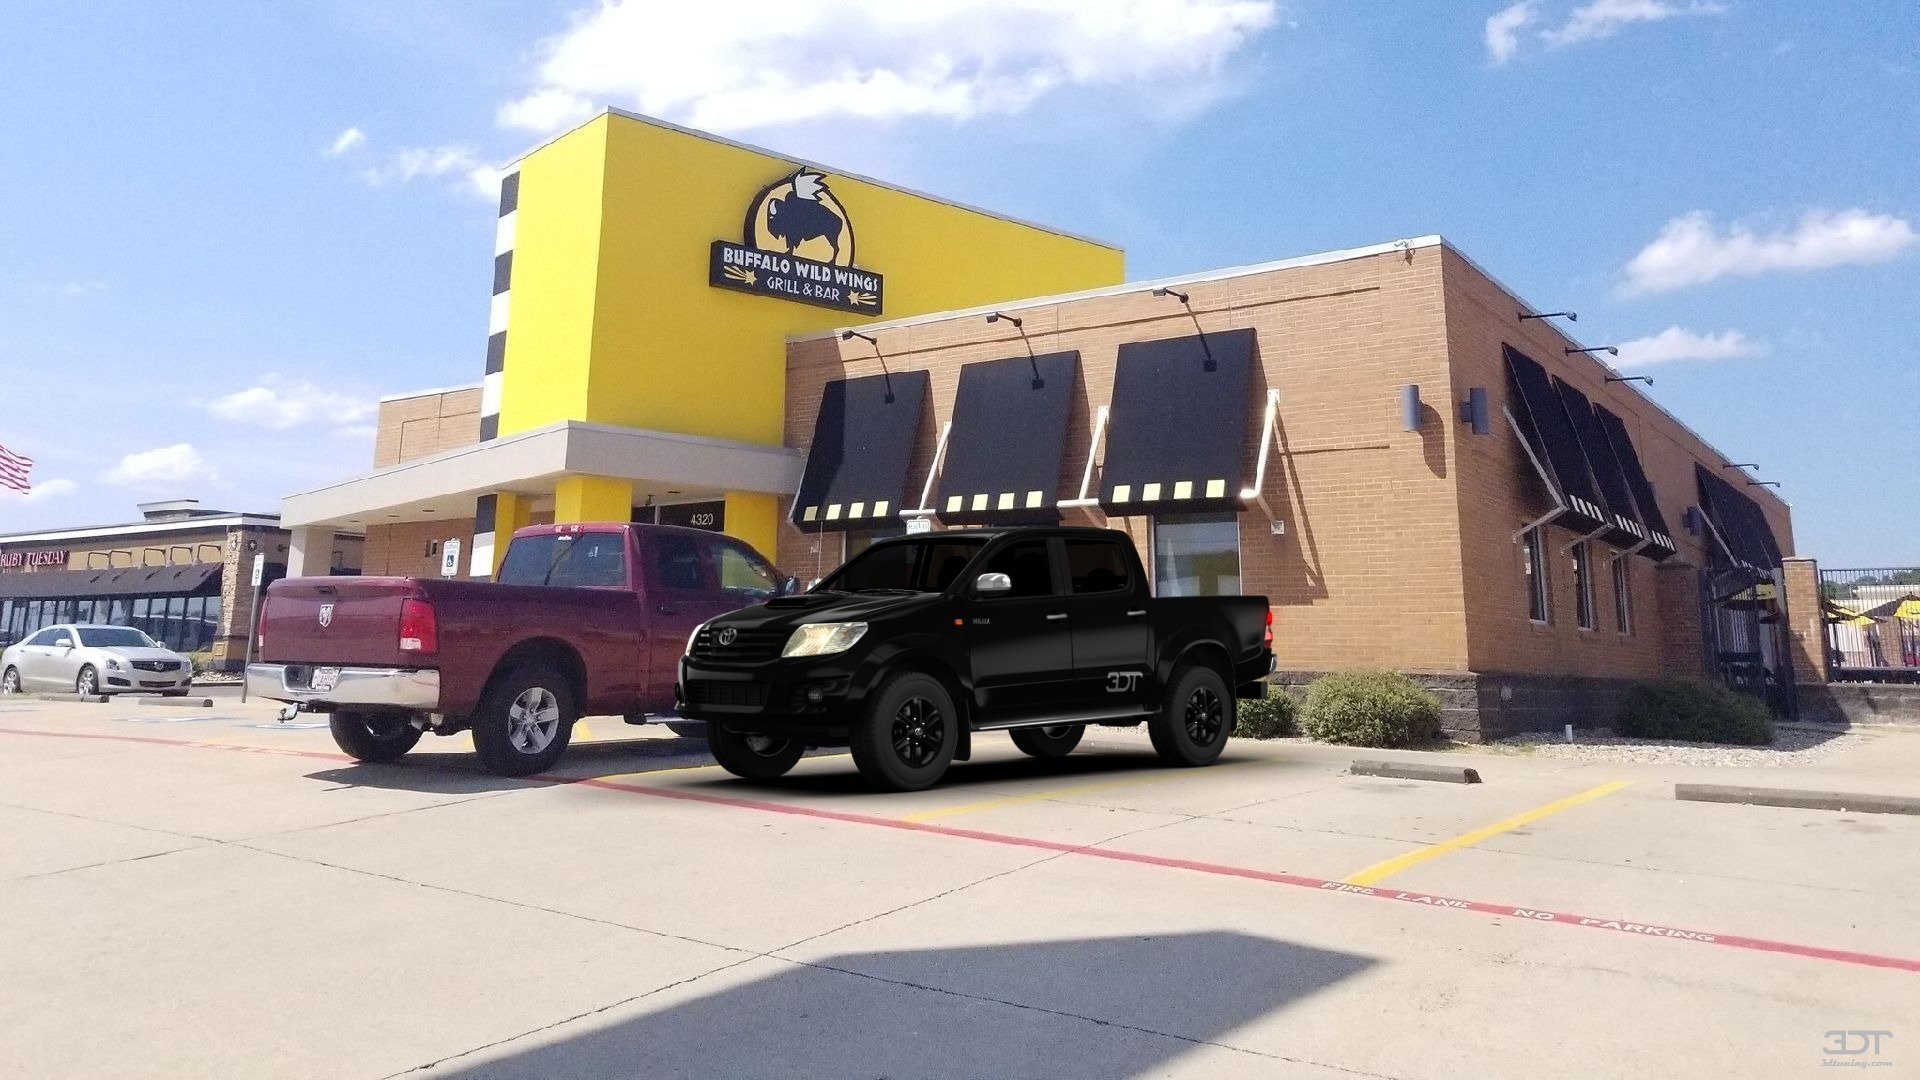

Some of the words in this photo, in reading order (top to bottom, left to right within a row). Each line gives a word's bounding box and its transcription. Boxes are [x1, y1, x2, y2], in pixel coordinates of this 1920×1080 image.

[723, 246, 790, 274] BUFFALO
[795, 261, 831, 282] WILD
[835, 269, 878, 292] WINGS
[767, 276, 799, 295] GRILL
[803, 283, 812, 297] &
[815, 285, 840, 302] BAR
[691, 514, 713, 525] 4320
[0, 553, 22, 567] RUBY
[26, 550, 65, 566] TUESDAY
[1106, 671, 1143, 693] 3DT
[1320, 881, 1376, 896] FIRE
[1395, 892, 1471, 909] LANE
[1512, 909, 1555, 920] NO
[1578, 916, 1717, 943] PARKING
